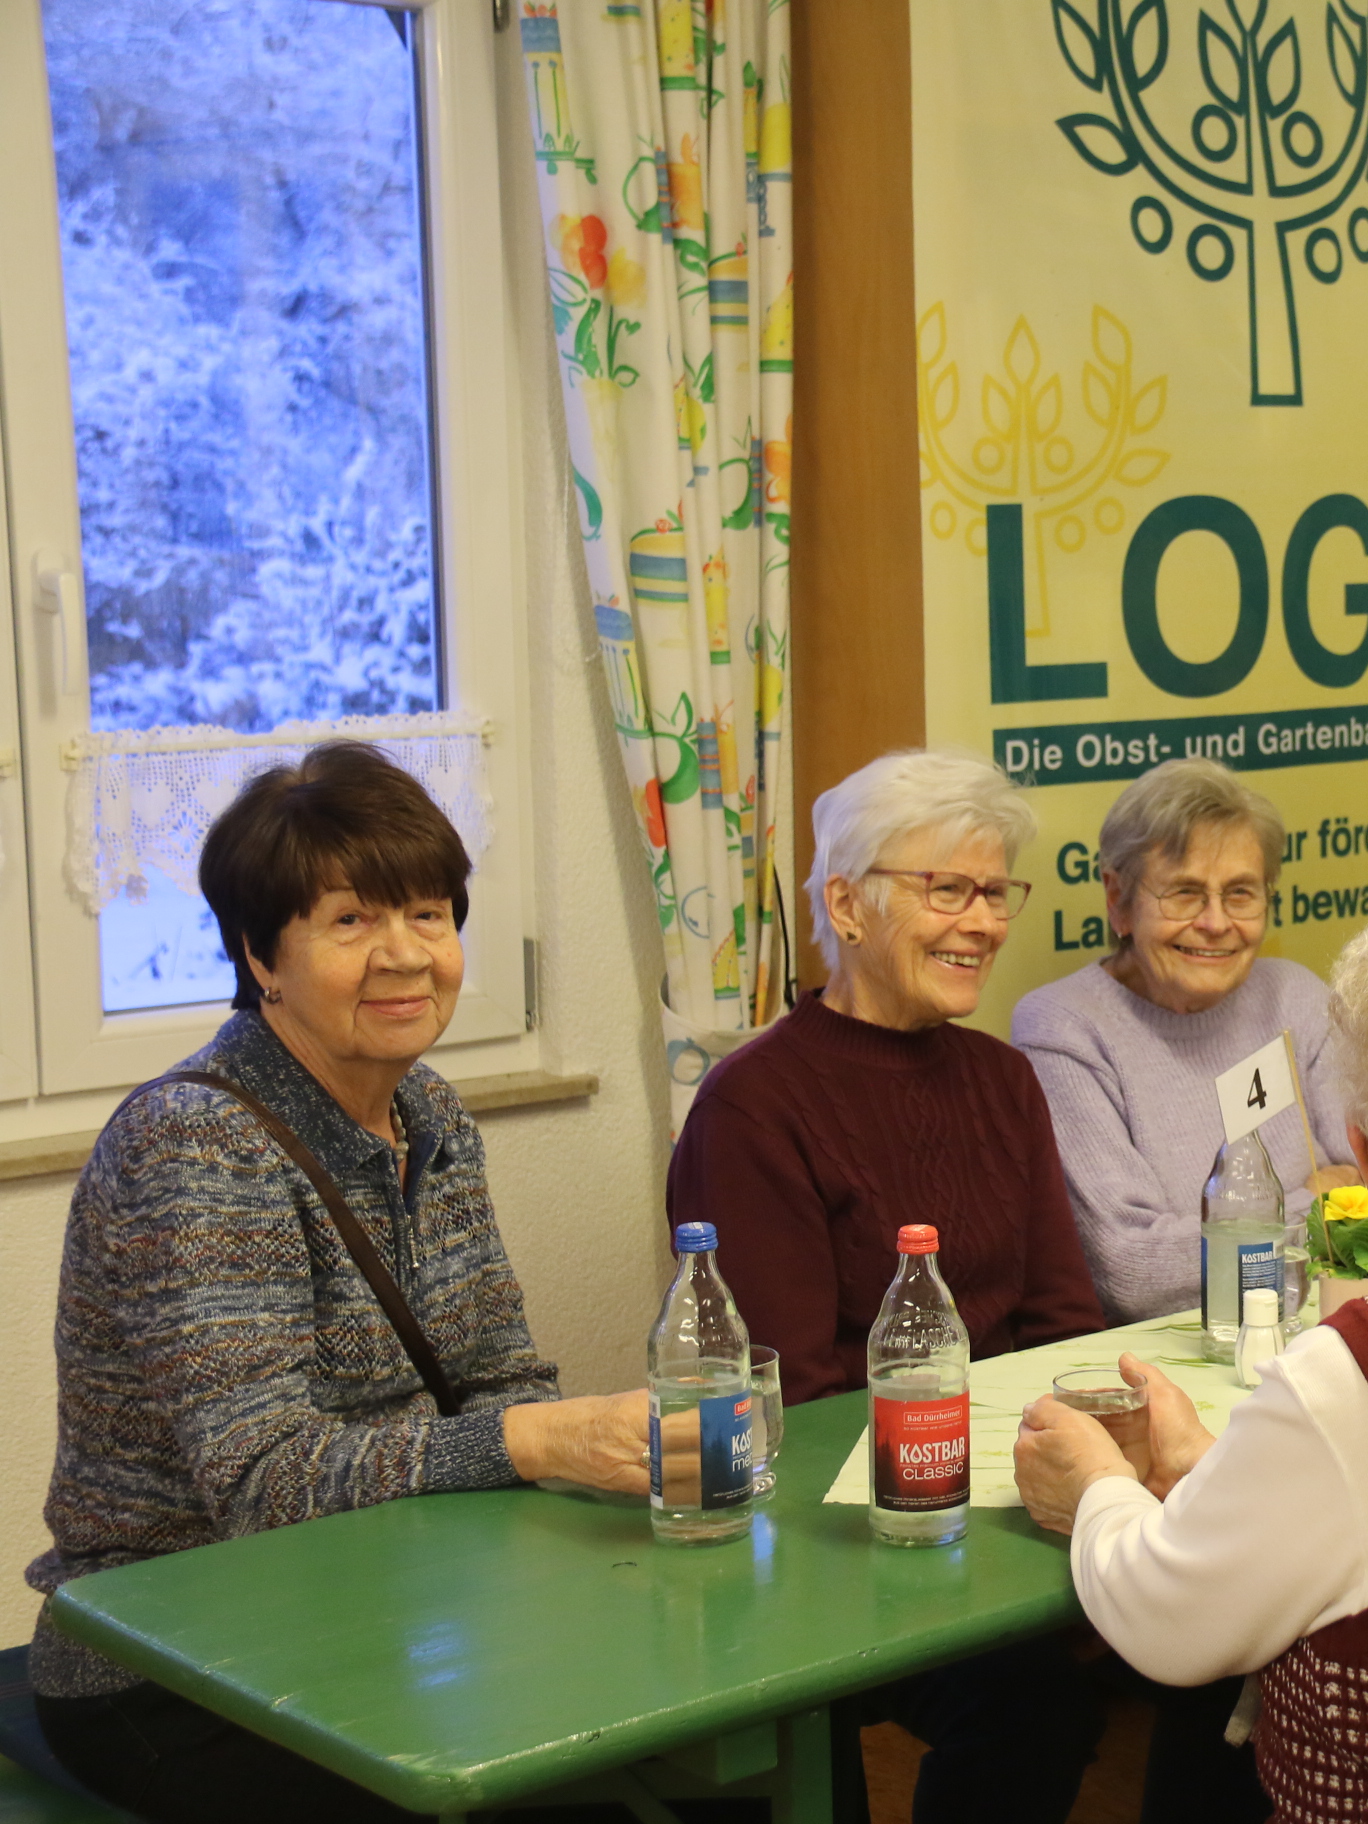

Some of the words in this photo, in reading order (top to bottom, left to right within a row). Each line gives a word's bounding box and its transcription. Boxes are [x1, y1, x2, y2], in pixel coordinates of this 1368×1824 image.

[1005, 738, 1063, 773] Die
[1076, 733, 1171, 767] Obst-
[1185, 725, 1246, 758] und
[1247, 1067, 1267, 1110] 4
[1242, 1250, 1273, 1264] KOSTBAR
[907, 1414, 922, 1422] Bad
[924, 1409, 961, 1422] Dürrheimer
[899, 1436, 965, 1464] KOSTBAR
